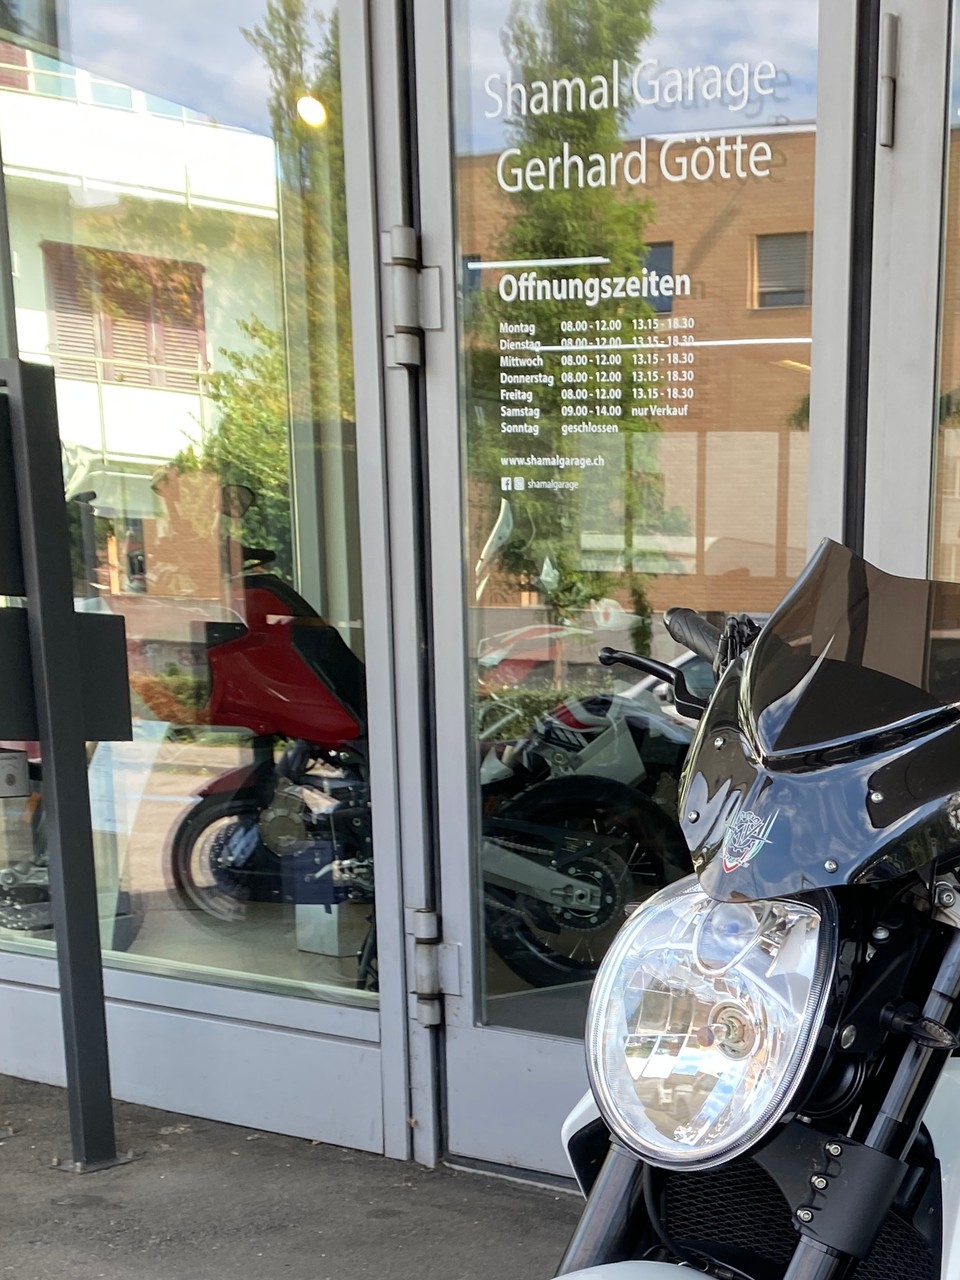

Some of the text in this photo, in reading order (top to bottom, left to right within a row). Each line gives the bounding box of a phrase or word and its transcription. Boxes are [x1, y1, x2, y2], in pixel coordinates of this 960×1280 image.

[484, 58, 777, 118] Shamal Garage
[496, 135, 772, 193] Gerhard Götte
[500, 322, 535, 335] Montag
[561, 320, 587, 331] 08.00
[595, 319, 621, 331] 12.00
[632, 318, 658, 330] 13.15
[667, 317, 694, 329] 18.30
[500, 340, 541, 352] Dienstag
[500, 356, 543, 367] Mittwoch
[561, 355, 587, 366] 08.00
[595, 354, 621, 365] 12.00
[632, 354, 658, 365] 13.15
[667, 353, 694, 364] 18.30
[500, 373, 554, 386] Donnerstag
[561, 372, 587, 383] 08.00
[595, 372, 621, 383] 12.00
[632, 371, 658, 382] 13.15
[667, 370, 694, 381] 18.30
[501, 390, 533, 402] Freitag
[561, 389, 587, 400] 08.00
[595, 389, 621, 400] 12.00
[632, 388, 658, 399] 13.15
[667, 387, 694, 399] 18.30
[501, 406, 540, 418] Samstag
[561, 406, 587, 416] 09.00
[595, 406, 621, 416] 14.00
[632, 407, 648, 416] nur
[650, 405, 689, 416] Verkauf
[501, 422, 618, 435] Sonntag geschlossen
[501, 455, 605, 468] www.shamalgarage.ch
[527, 479, 579, 491] shamalgarage
